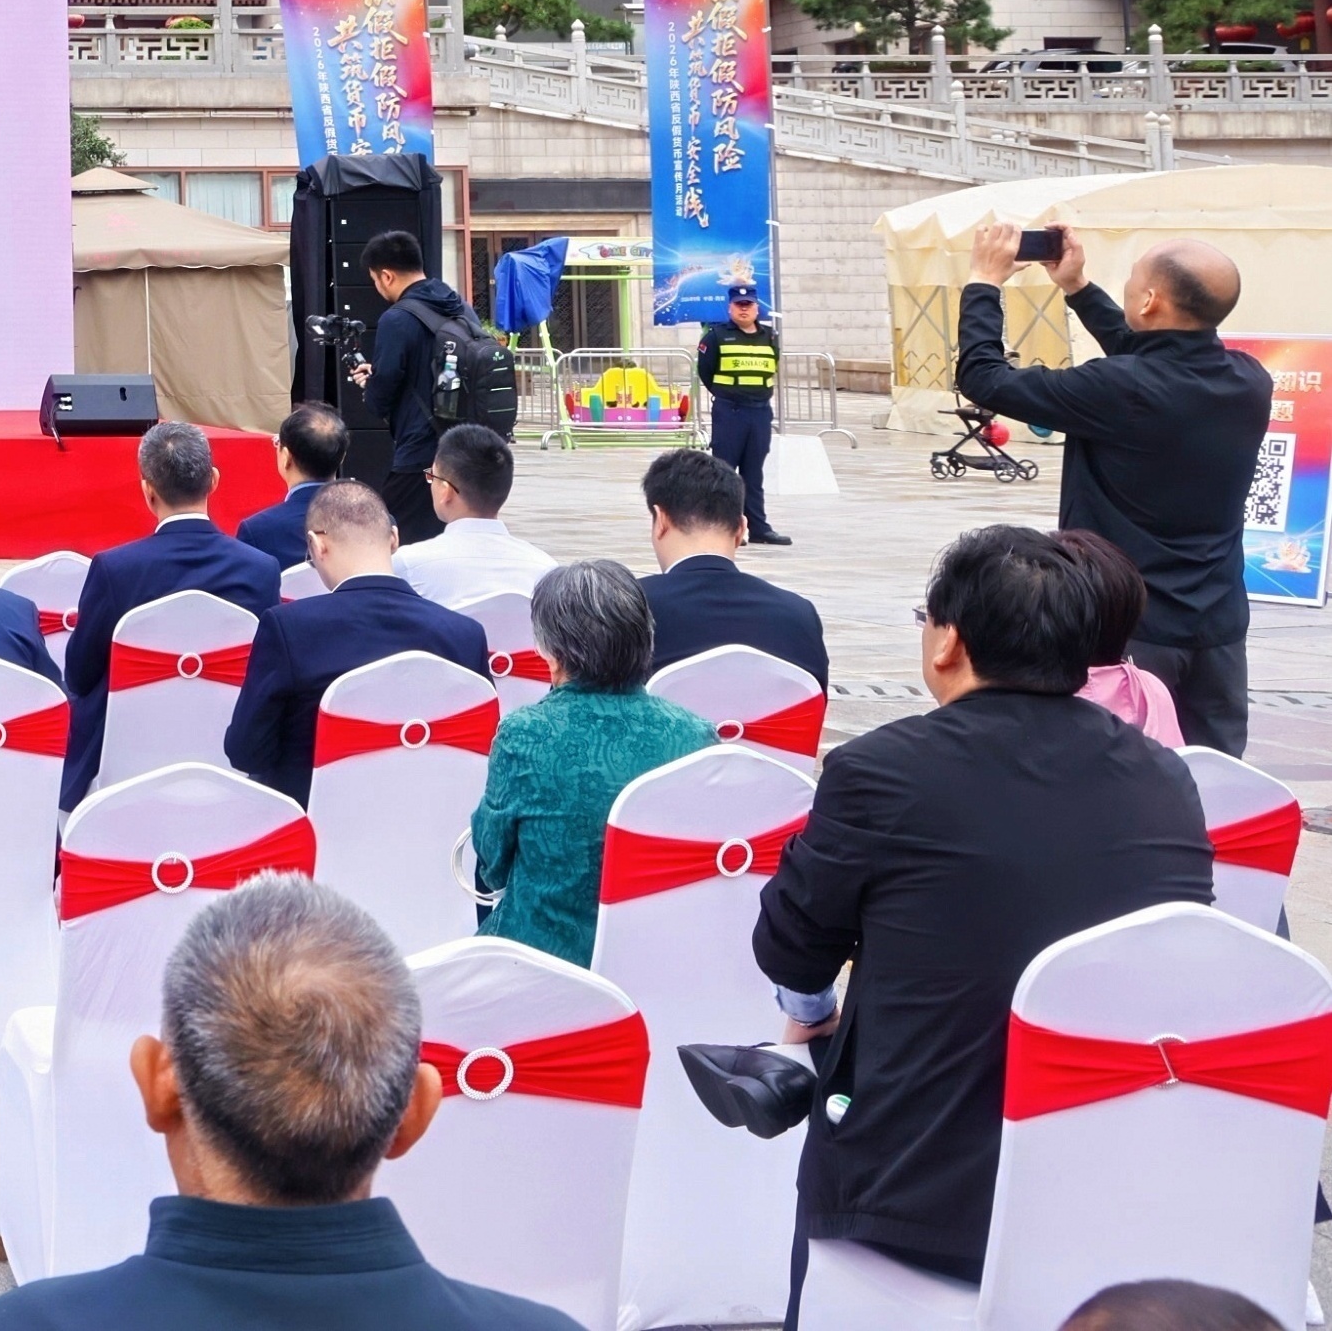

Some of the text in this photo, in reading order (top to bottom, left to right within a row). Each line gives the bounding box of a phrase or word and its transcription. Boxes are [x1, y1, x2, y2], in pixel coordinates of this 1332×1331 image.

[667, 21, 684, 217] 2026年陕西省反假货币宣传月活动
[681, 10, 710, 228] 共筑货币安全线
